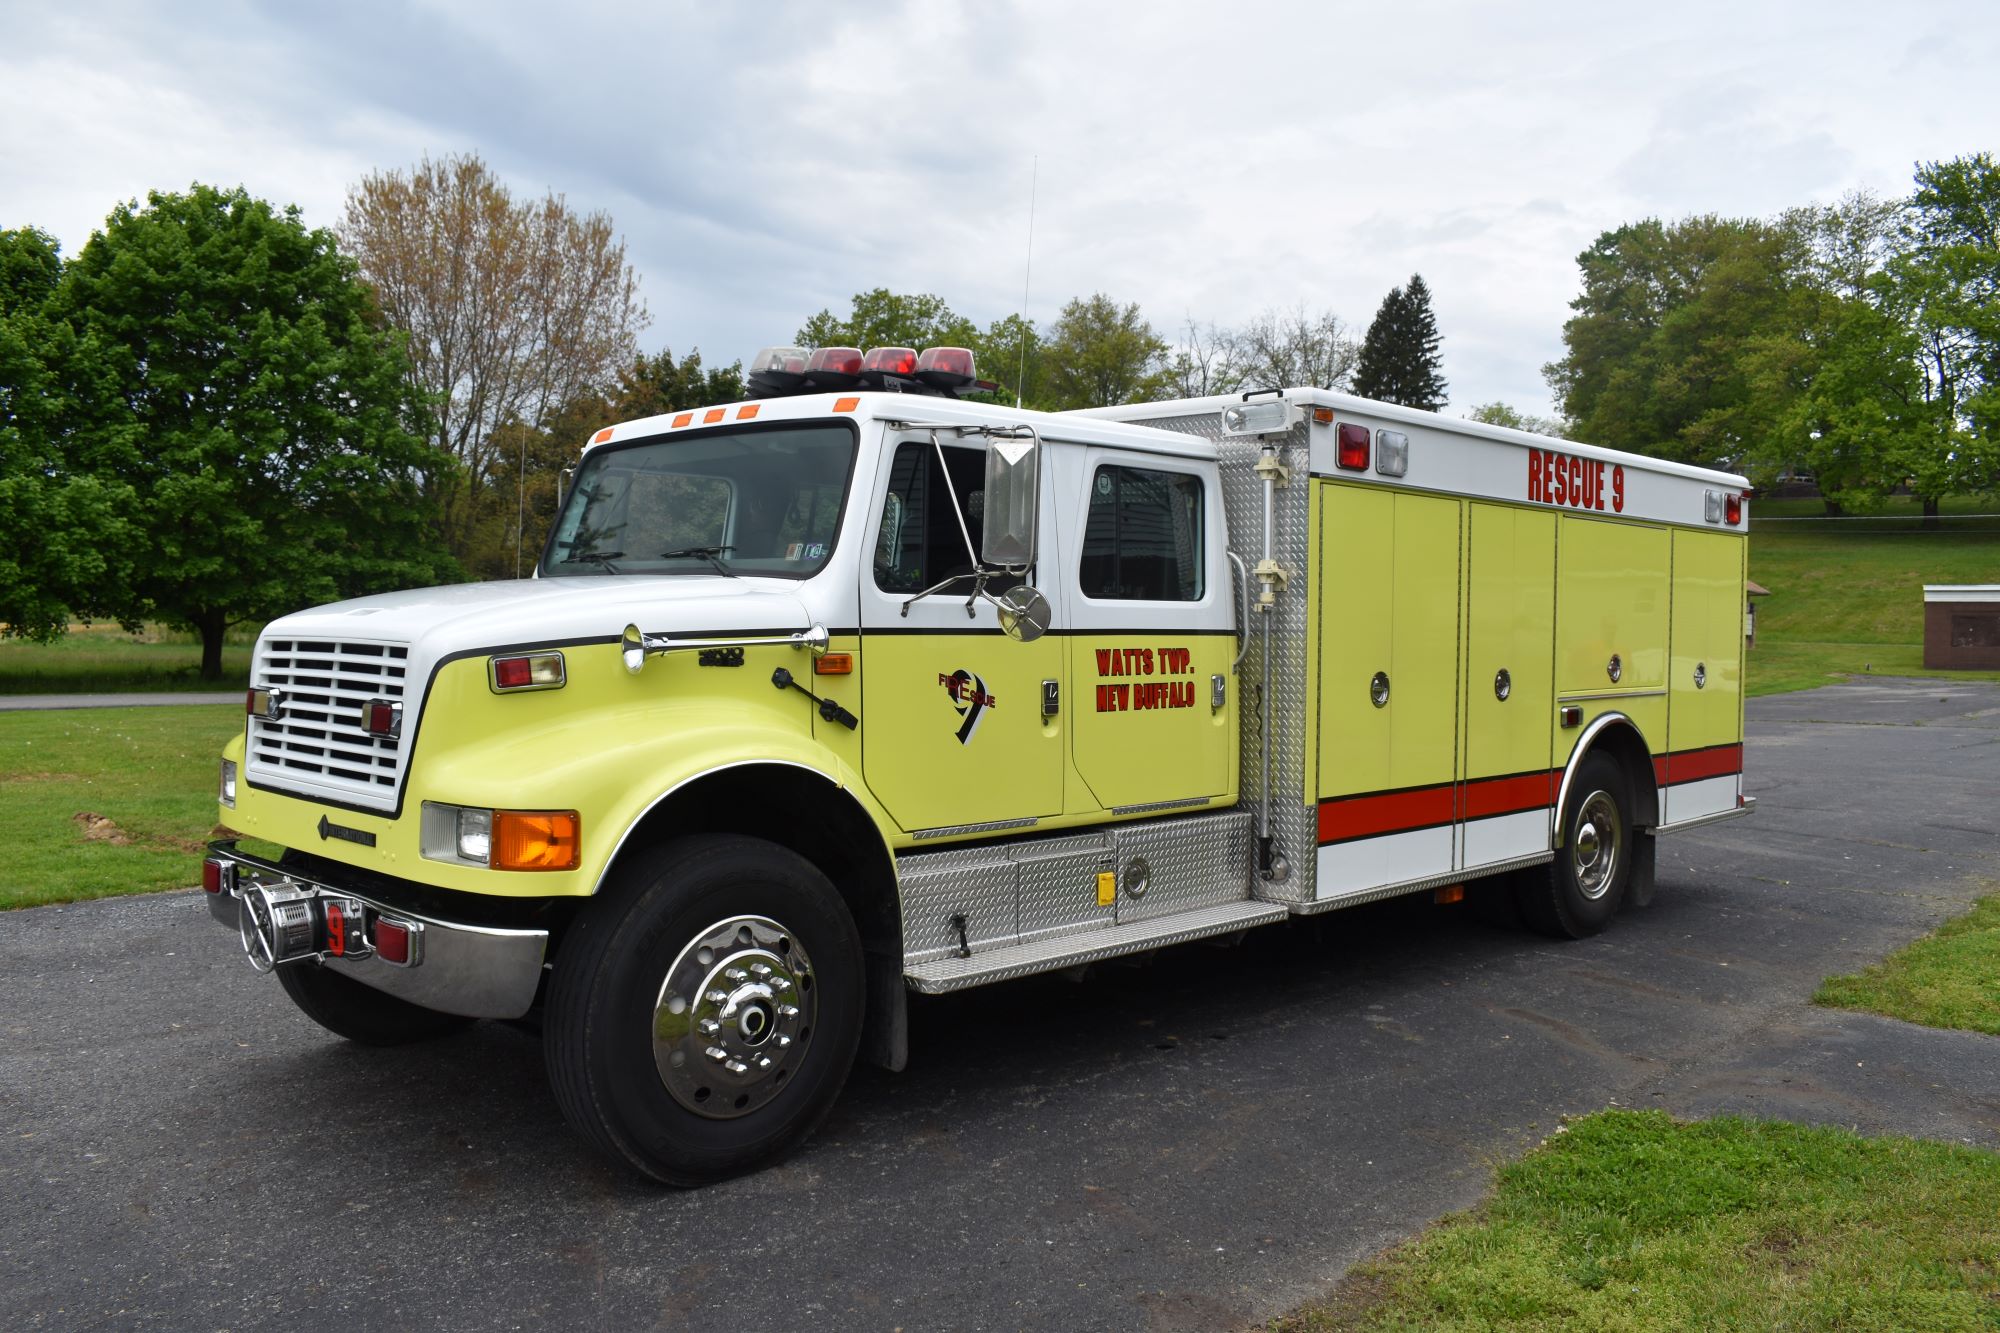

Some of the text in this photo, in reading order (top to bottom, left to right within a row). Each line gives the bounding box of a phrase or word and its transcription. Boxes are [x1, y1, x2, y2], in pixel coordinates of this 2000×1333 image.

[1528, 448, 1624, 513] RESCUE 9
[1095, 648, 1195, 677] WATTS TWP.
[1096, 681, 1195, 713] NEW BUFFALO
[327, 904, 344, 957] 9
